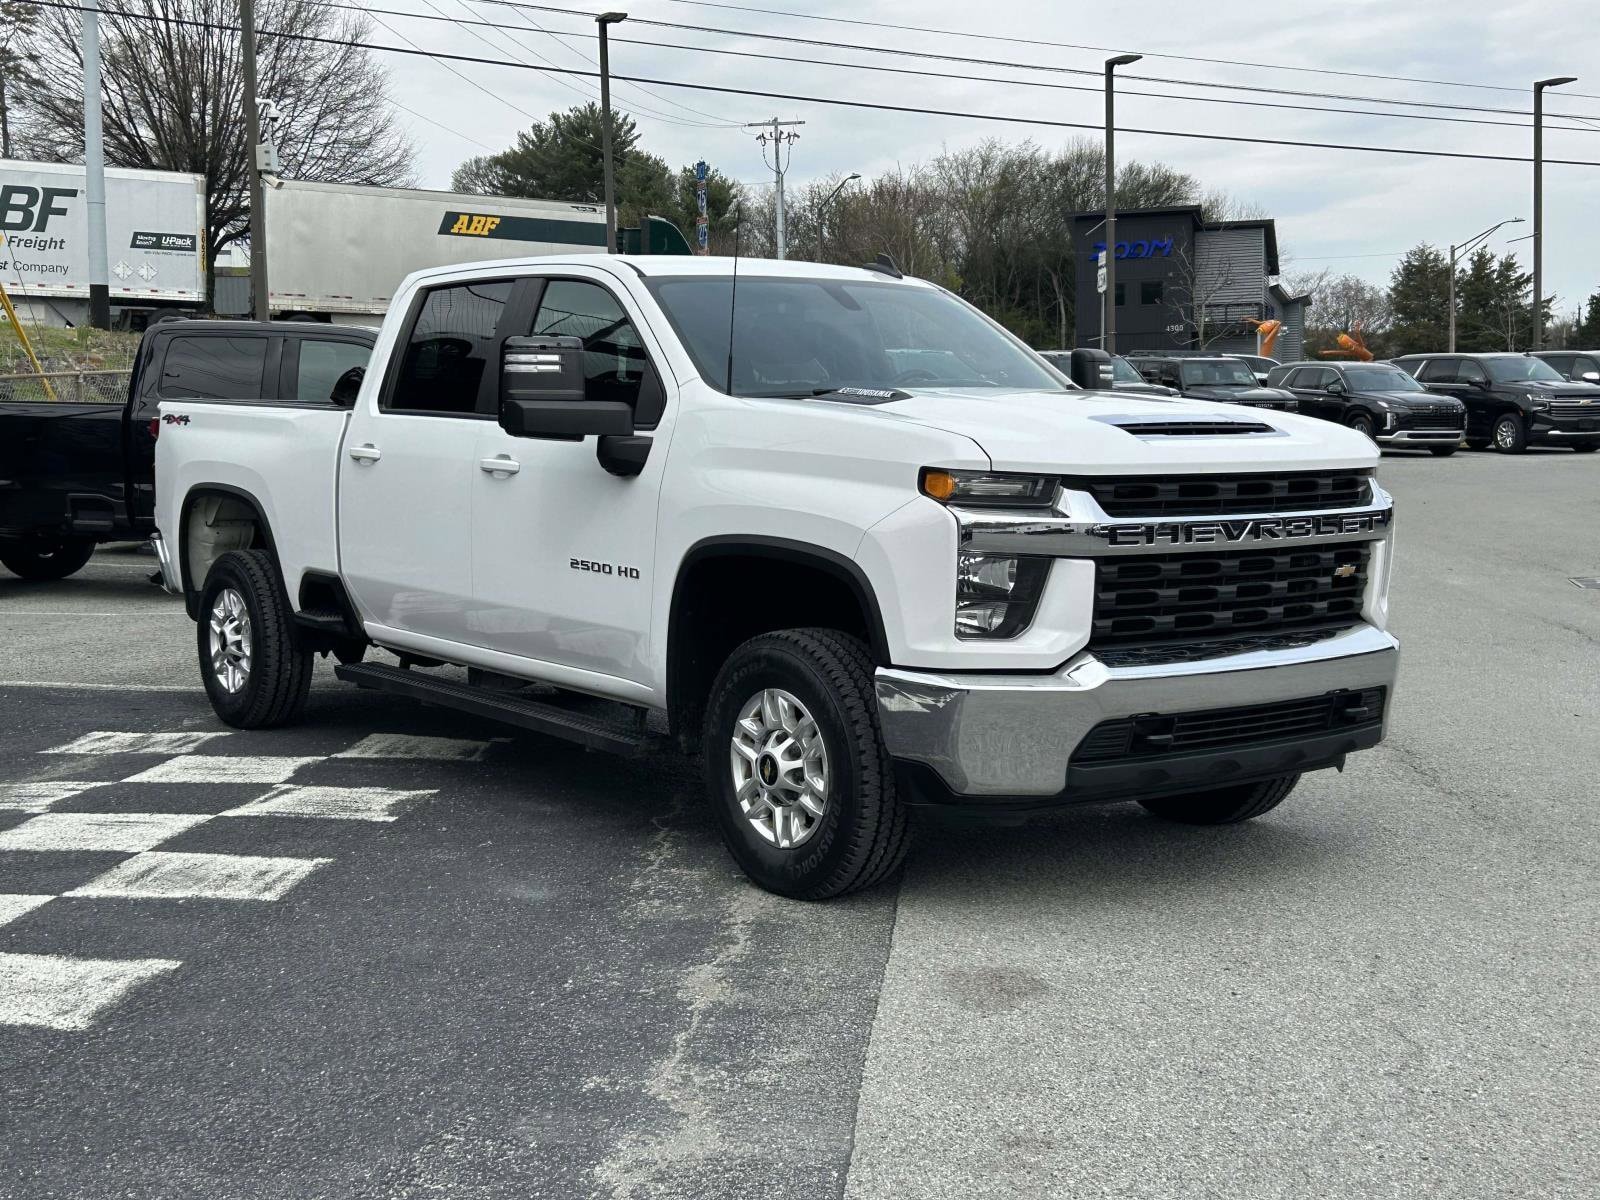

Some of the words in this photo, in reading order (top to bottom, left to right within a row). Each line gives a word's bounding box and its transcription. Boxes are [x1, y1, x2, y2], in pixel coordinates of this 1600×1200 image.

[451, 215, 500, 235] ABF
[8, 236, 66, 251] Freight
[13, 260, 69, 275] Company
[1107, 513, 1381, 546] CHEVROLET
[570, 558, 612, 575] 2500
[617, 565, 640, 579] HD
